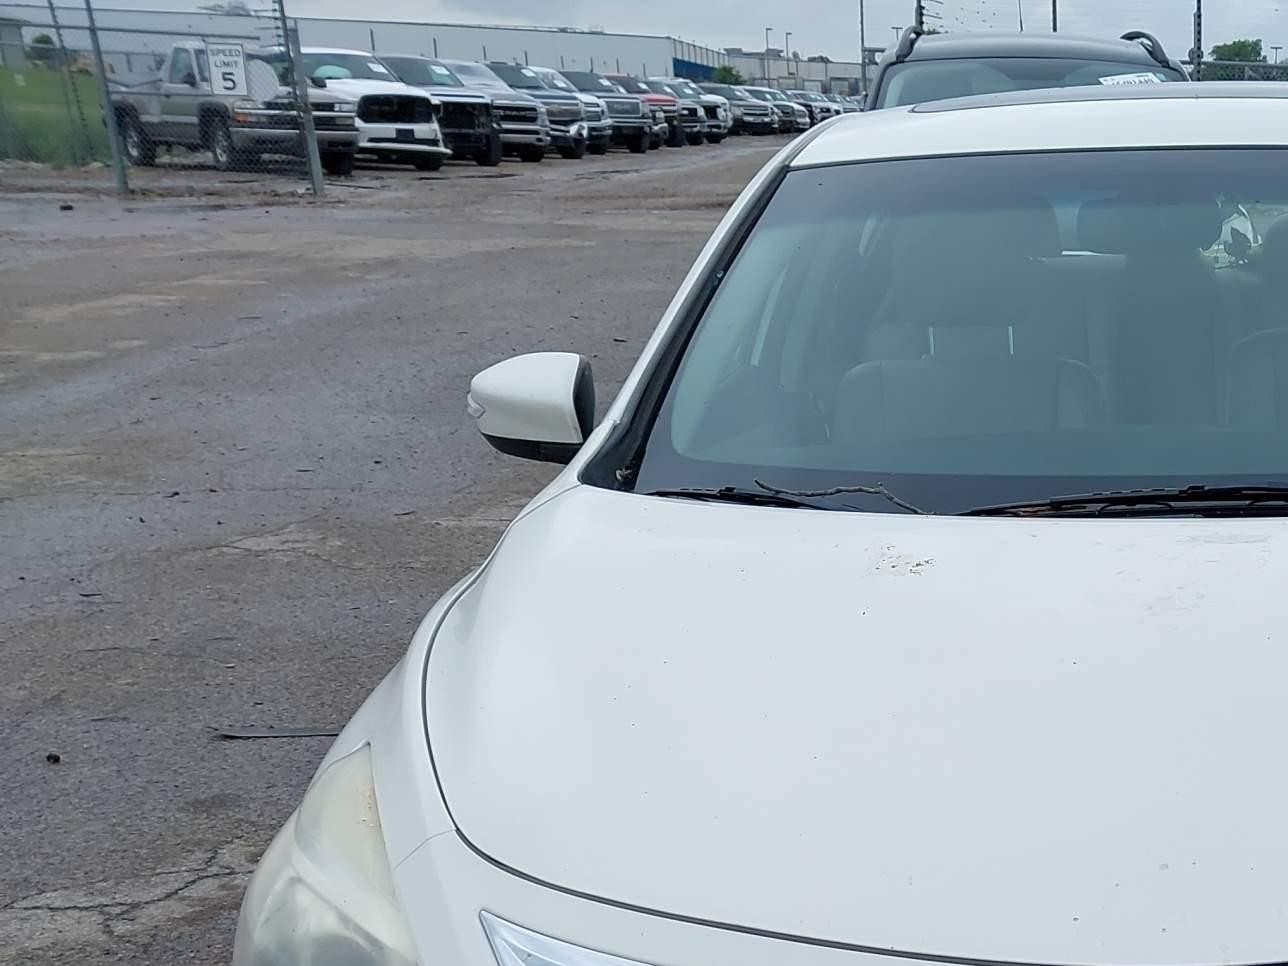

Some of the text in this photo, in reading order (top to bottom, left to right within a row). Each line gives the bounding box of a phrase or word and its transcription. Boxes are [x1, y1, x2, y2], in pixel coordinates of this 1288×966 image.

[209, 48, 241, 57] SPEED
[214, 60, 238, 68] LIMIT
[222, 71, 236, 91] 5
